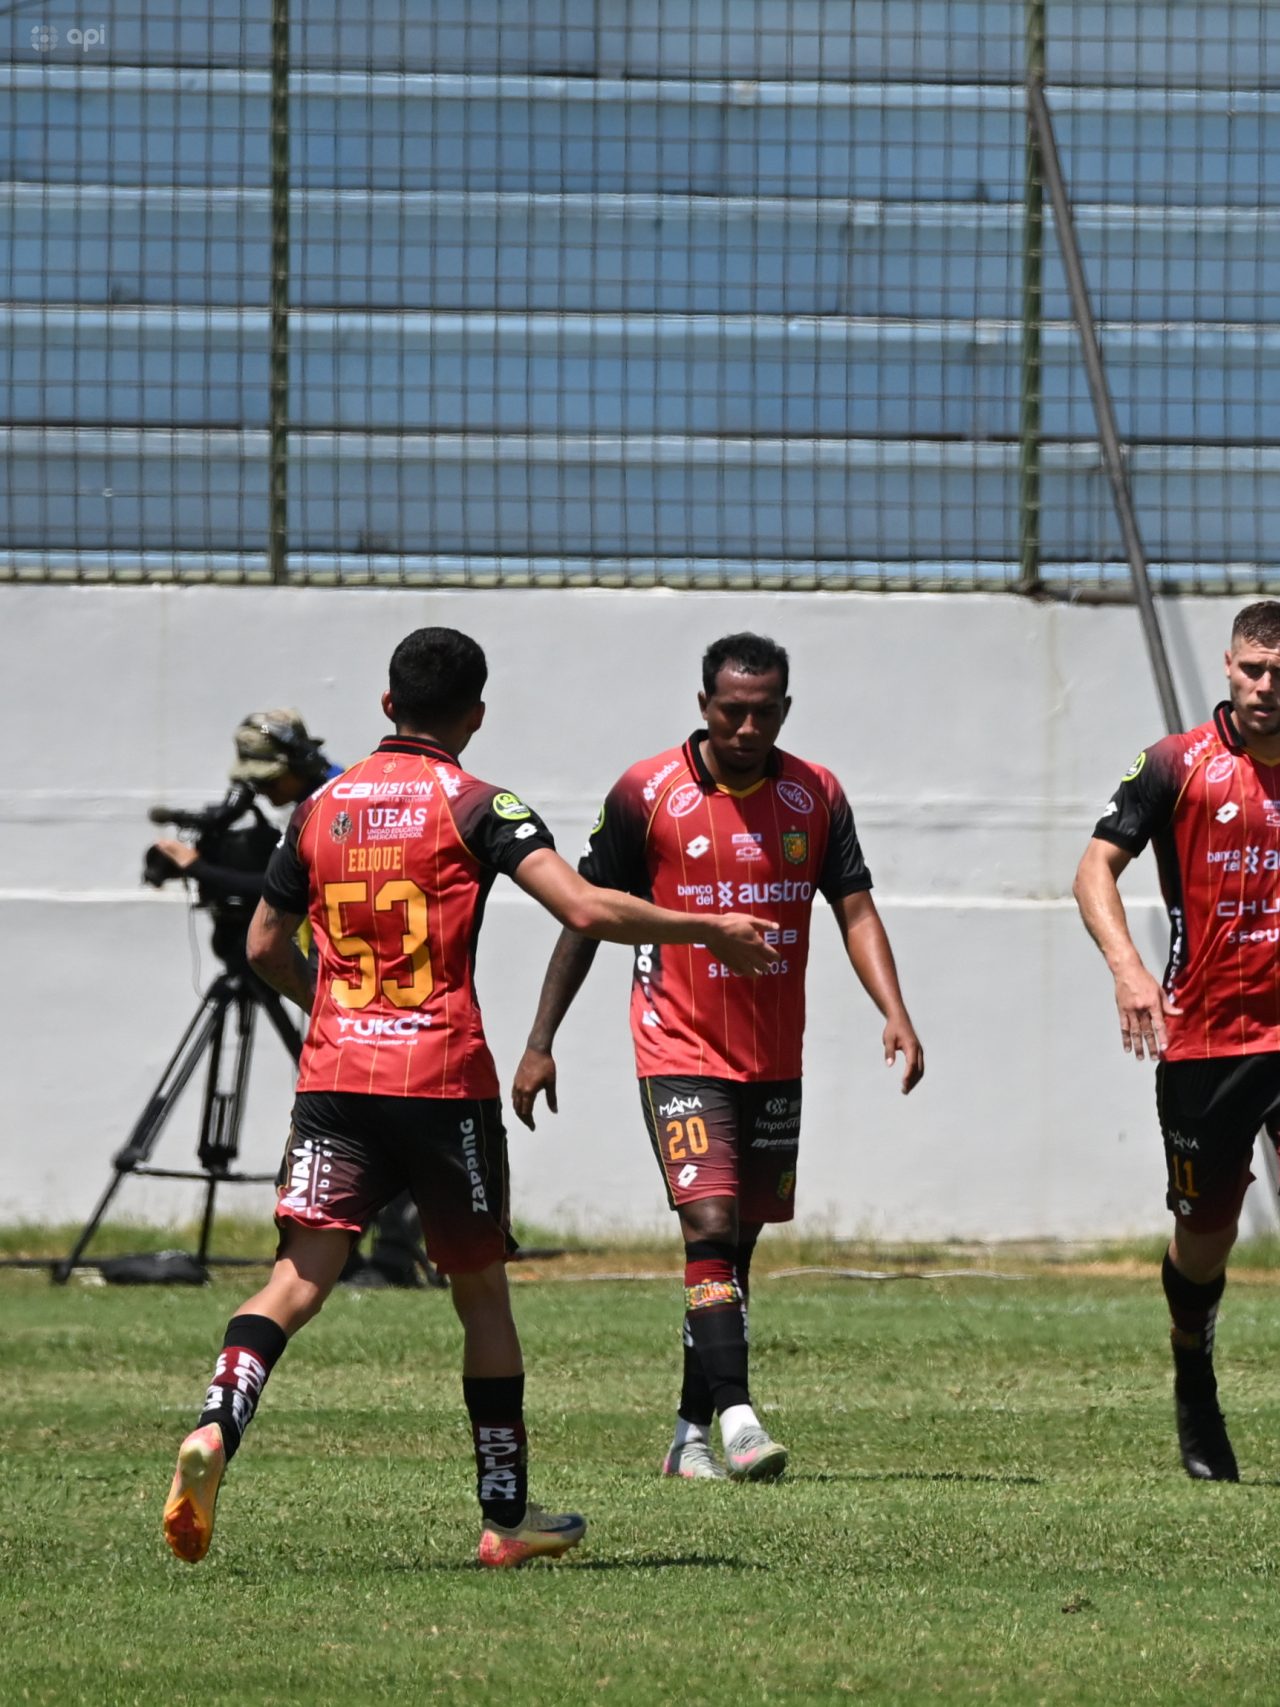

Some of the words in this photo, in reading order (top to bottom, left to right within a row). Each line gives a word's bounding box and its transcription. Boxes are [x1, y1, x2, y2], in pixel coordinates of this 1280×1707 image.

[367, 808, 427, 827] UEAS
[1207, 849, 1241, 863] banco
[677, 884, 713, 896] banco
[696, 892, 714, 905] del
[738, 879, 811, 904] austro
[322, 879, 435, 1010] 53
[707, 959, 788, 978] SEOS
[337, 1016, 419, 1036] YUKO
[659, 1096, 703, 1116] MANA
[666, 1116, 709, 1161] 20
